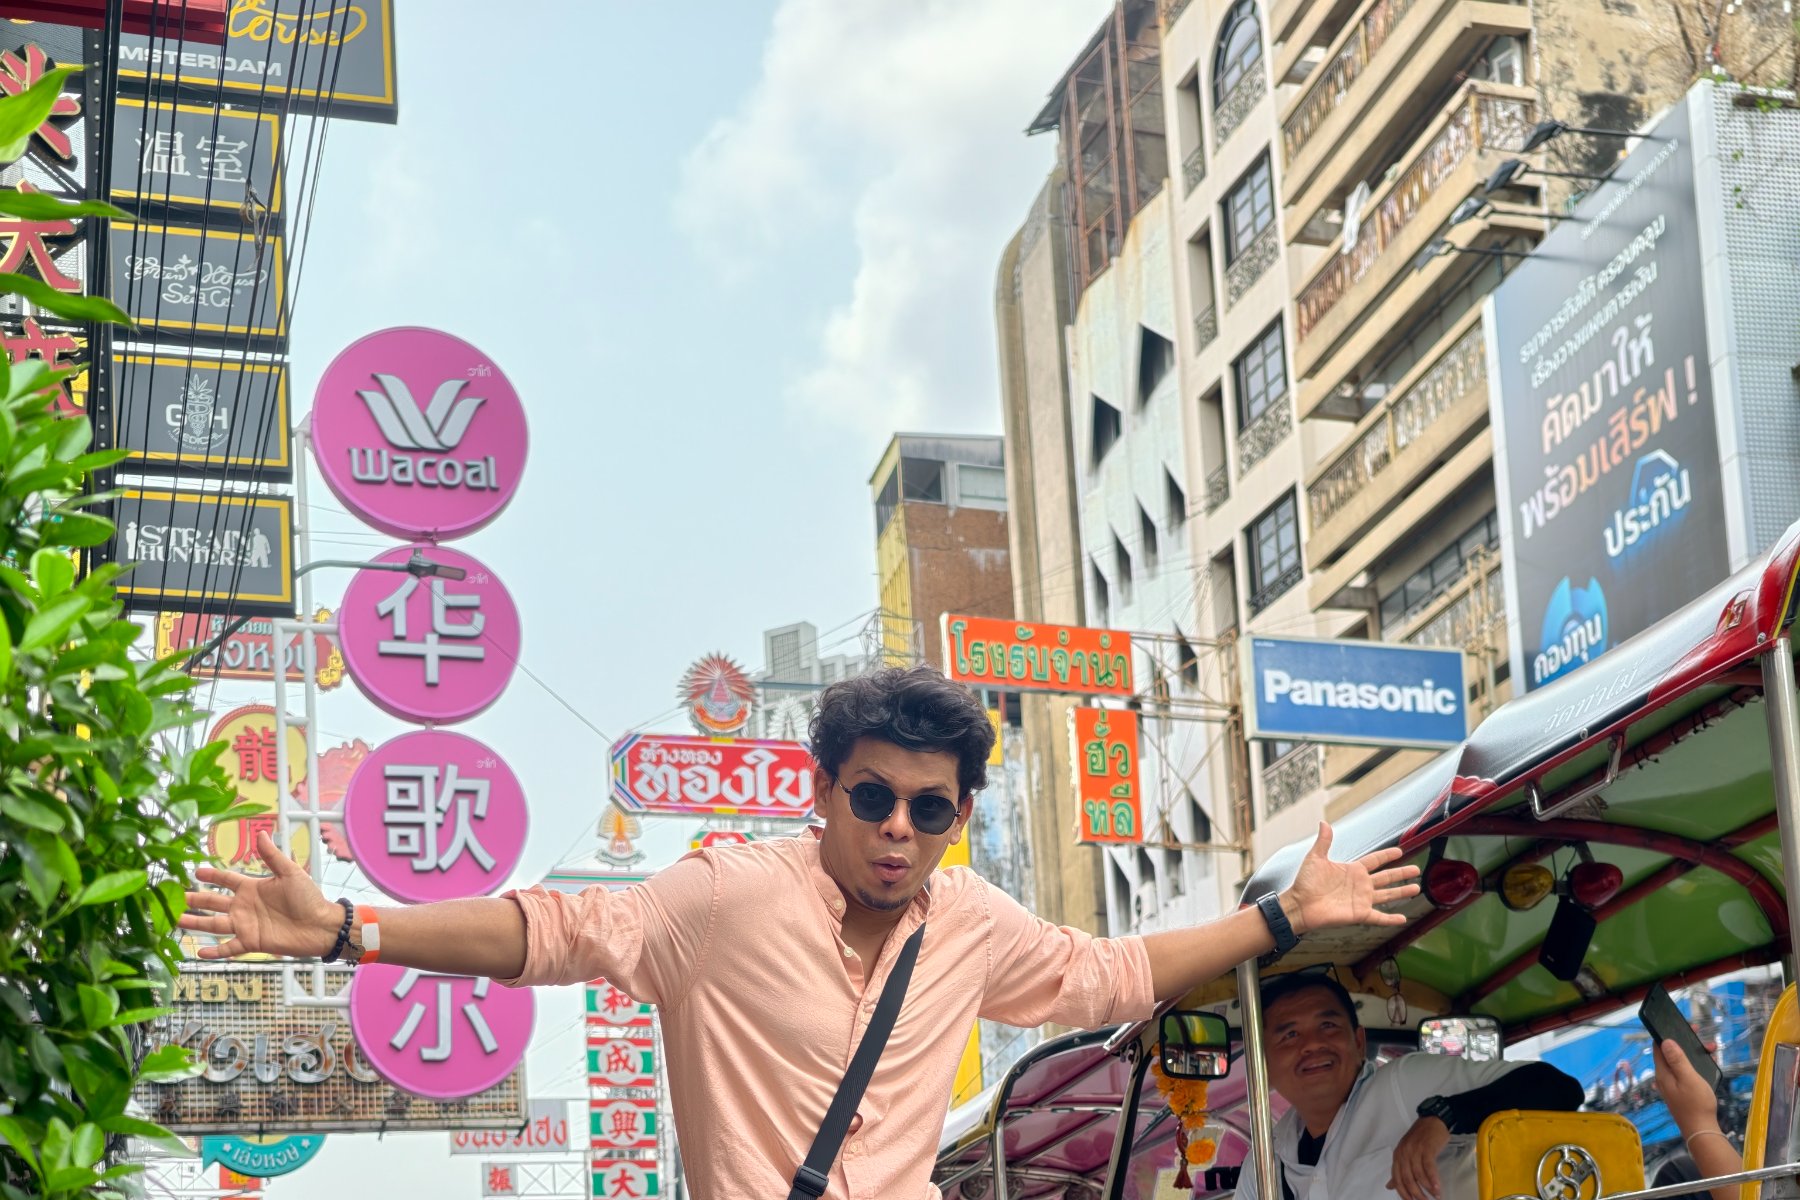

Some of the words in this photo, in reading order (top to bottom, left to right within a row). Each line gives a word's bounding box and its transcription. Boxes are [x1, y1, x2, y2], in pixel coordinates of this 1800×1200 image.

[119, 45, 282, 76] MSTERDAM
[135, 128, 249, 182] 温室
[1542, 313, 1655, 454] คัดมาให้
[348, 447, 500, 490] Wacoal
[1519, 366, 1678, 538] พร้อมเสิร์ฟ
[139, 524, 253, 553] STRAIN
[1603, 468, 1691, 558] ประกัน
[138, 545, 253, 568] HUNTERS
[951, 621, 1130, 689] โรงรับจำนำ
[1534, 613, 1602, 684] กองทุน
[1263, 668, 1457, 715] Panasonic
